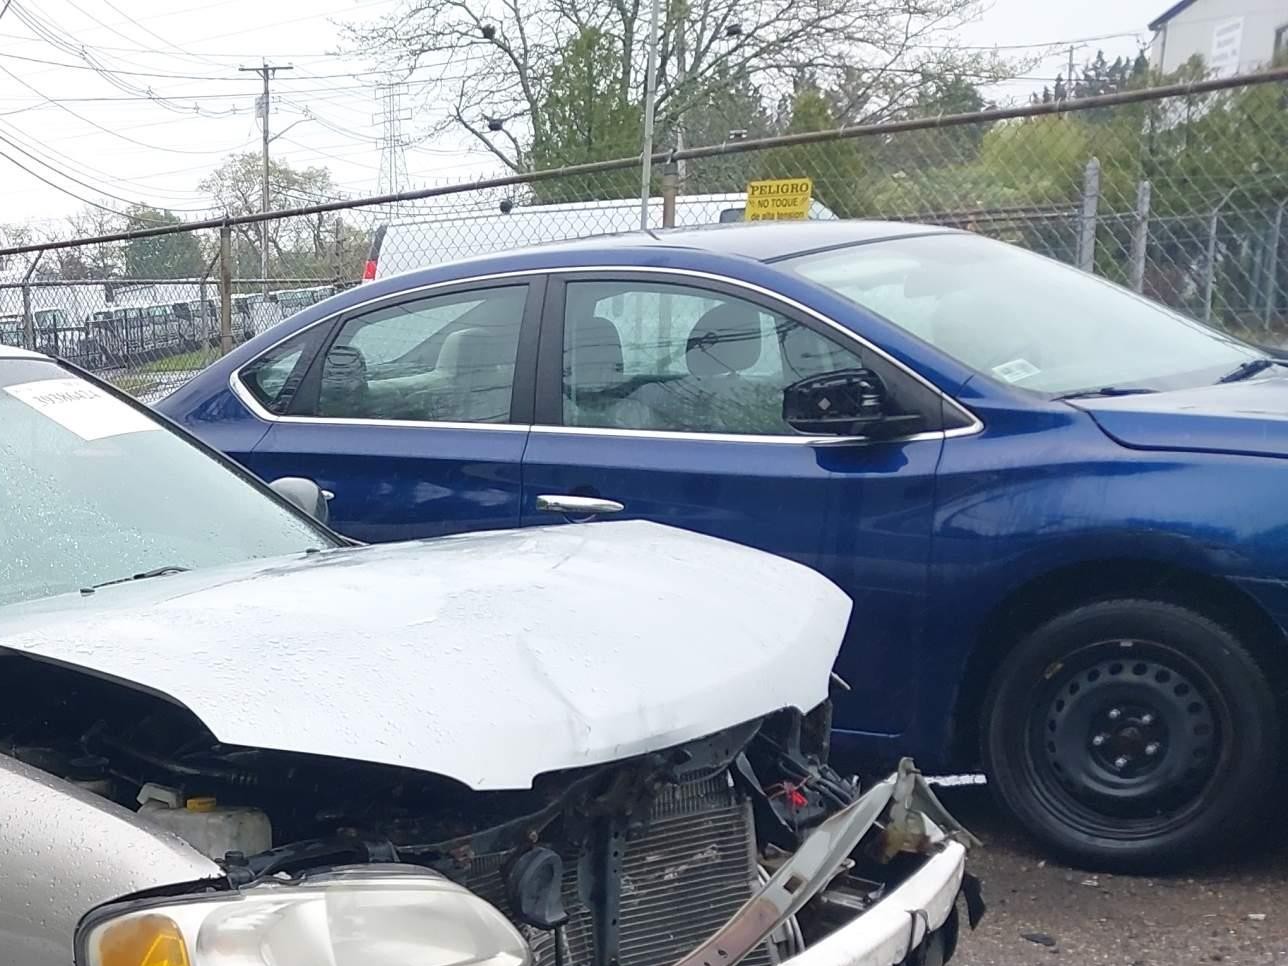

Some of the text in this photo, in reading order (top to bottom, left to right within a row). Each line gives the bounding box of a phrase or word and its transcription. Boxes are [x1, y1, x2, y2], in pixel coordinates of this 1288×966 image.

[750, 182, 809, 196] PELIGRO
[757, 197, 799, 208] NO TOQUE
